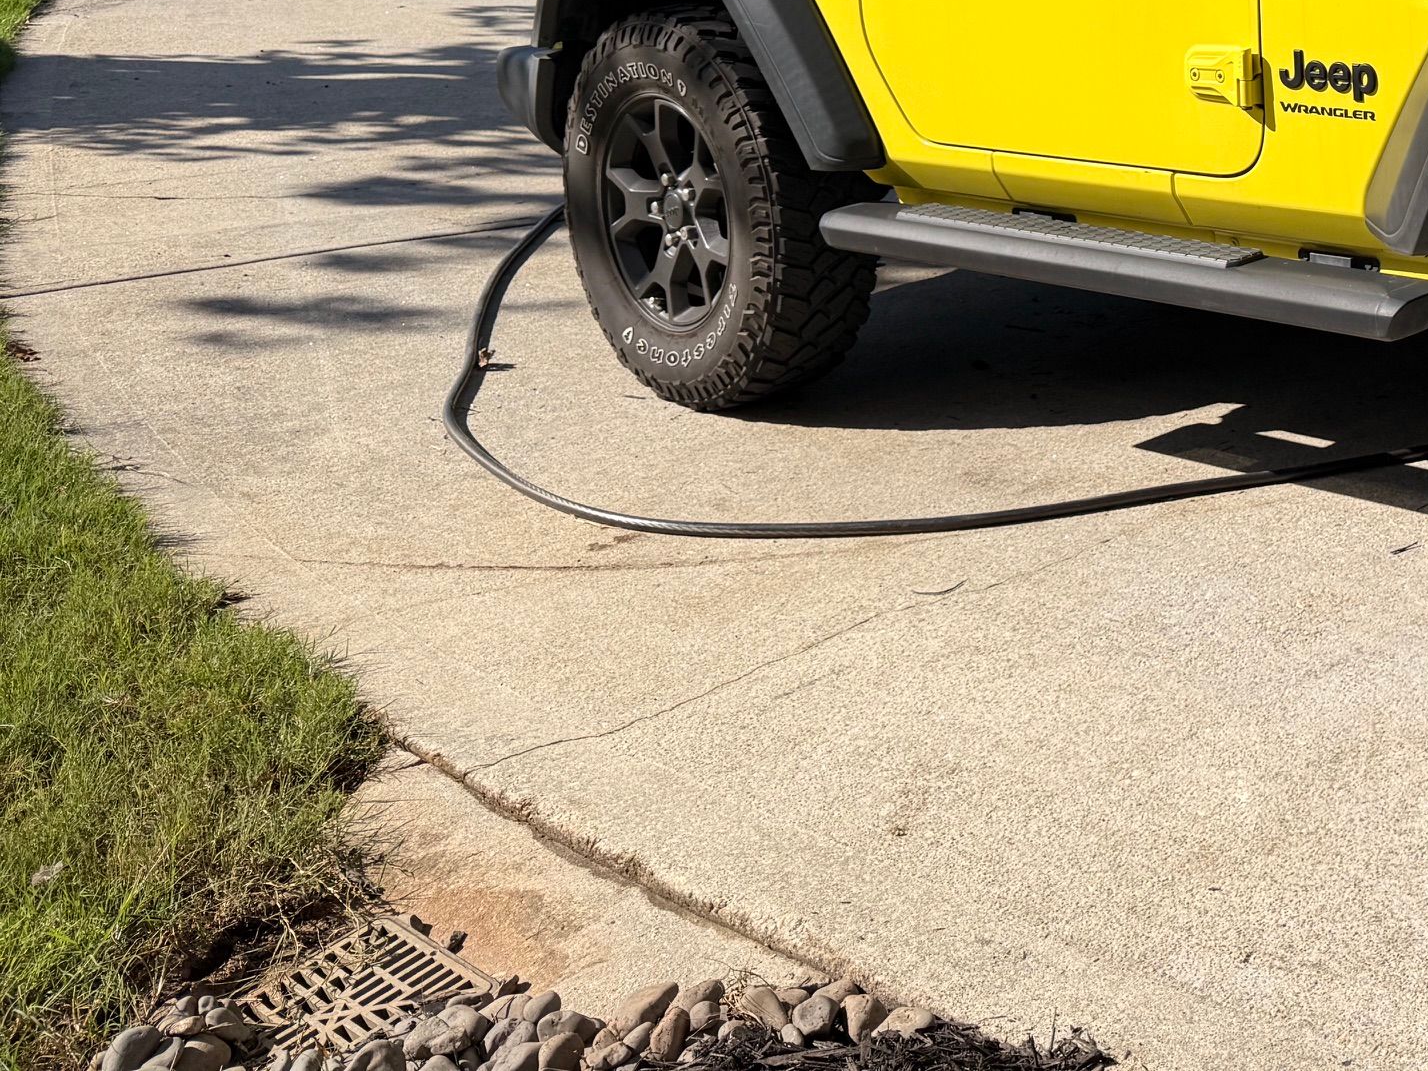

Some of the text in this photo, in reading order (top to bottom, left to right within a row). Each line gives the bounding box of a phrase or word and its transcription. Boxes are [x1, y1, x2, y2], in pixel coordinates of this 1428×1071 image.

[575, 61, 674, 155] DESTINATION
[1279, 49, 1378, 103] Jeep
[1279, 101, 1377, 121] WRANGLER
[636, 283, 738, 367] Firestone
